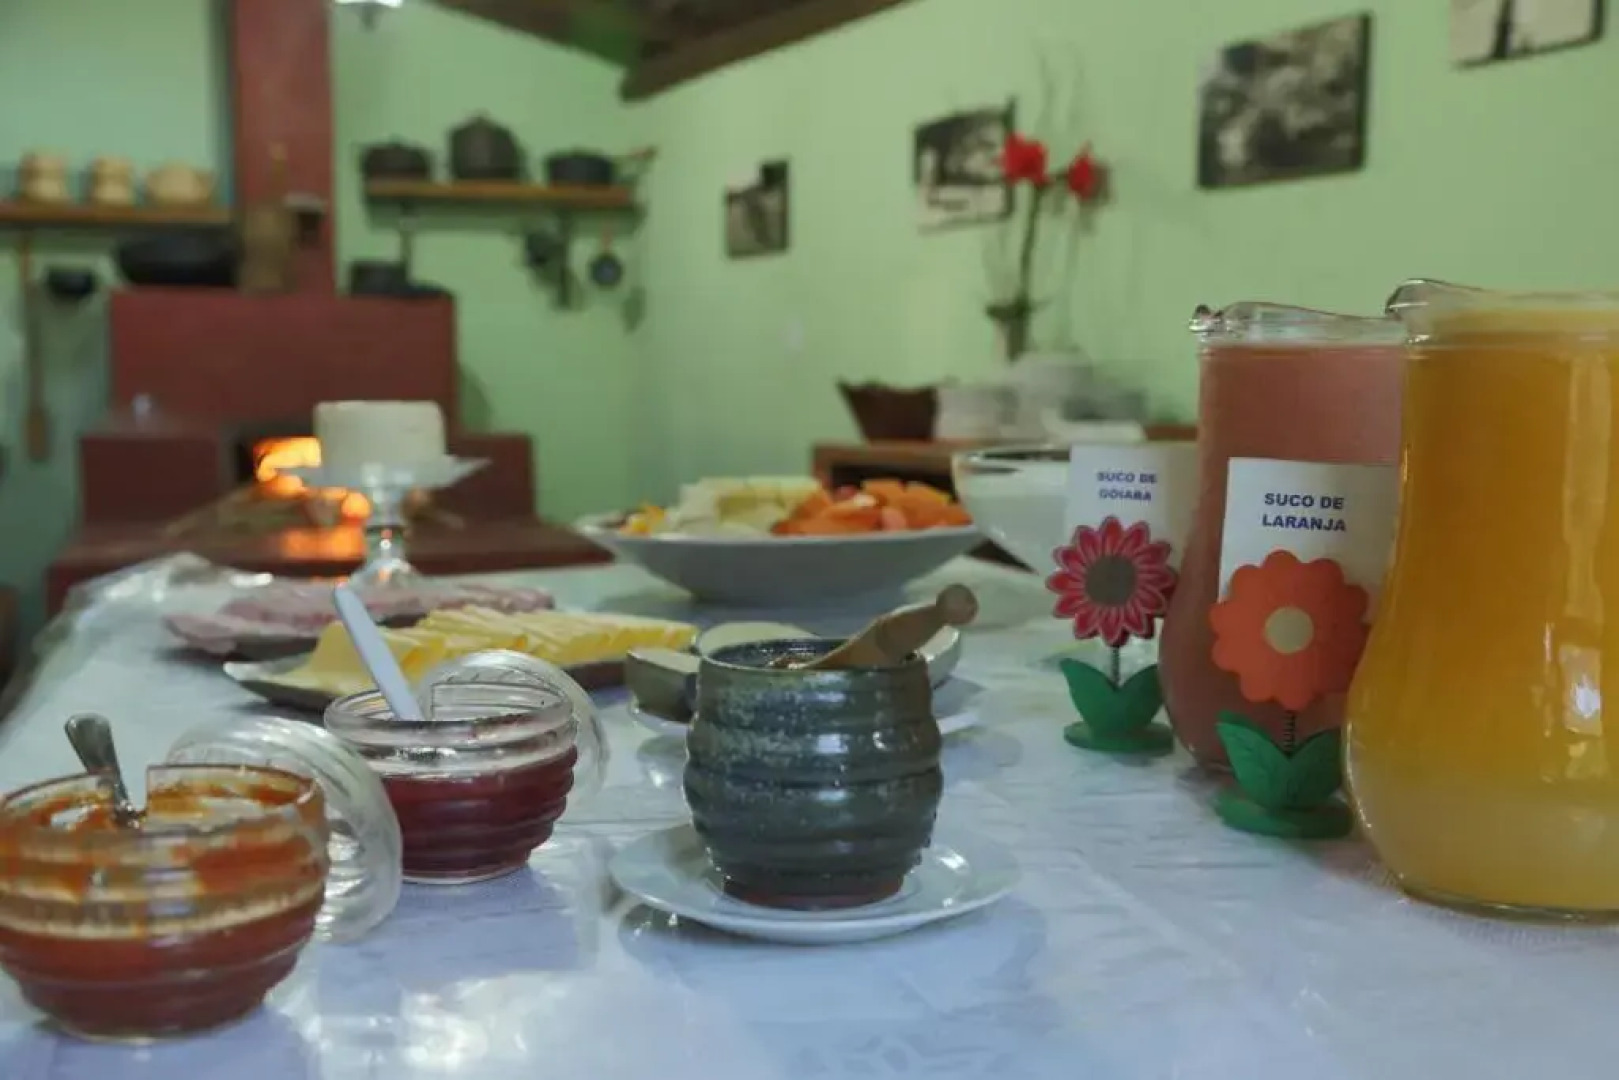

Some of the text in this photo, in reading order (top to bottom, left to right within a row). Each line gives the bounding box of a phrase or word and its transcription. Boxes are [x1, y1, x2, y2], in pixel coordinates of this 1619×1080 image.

[1096, 471, 1157, 484] SUCO DE
[1098, 488, 1152, 501] GOIABA
[1264, 492, 1345, 510] SUCO DE
[1262, 513, 1346, 532] LARANJA
